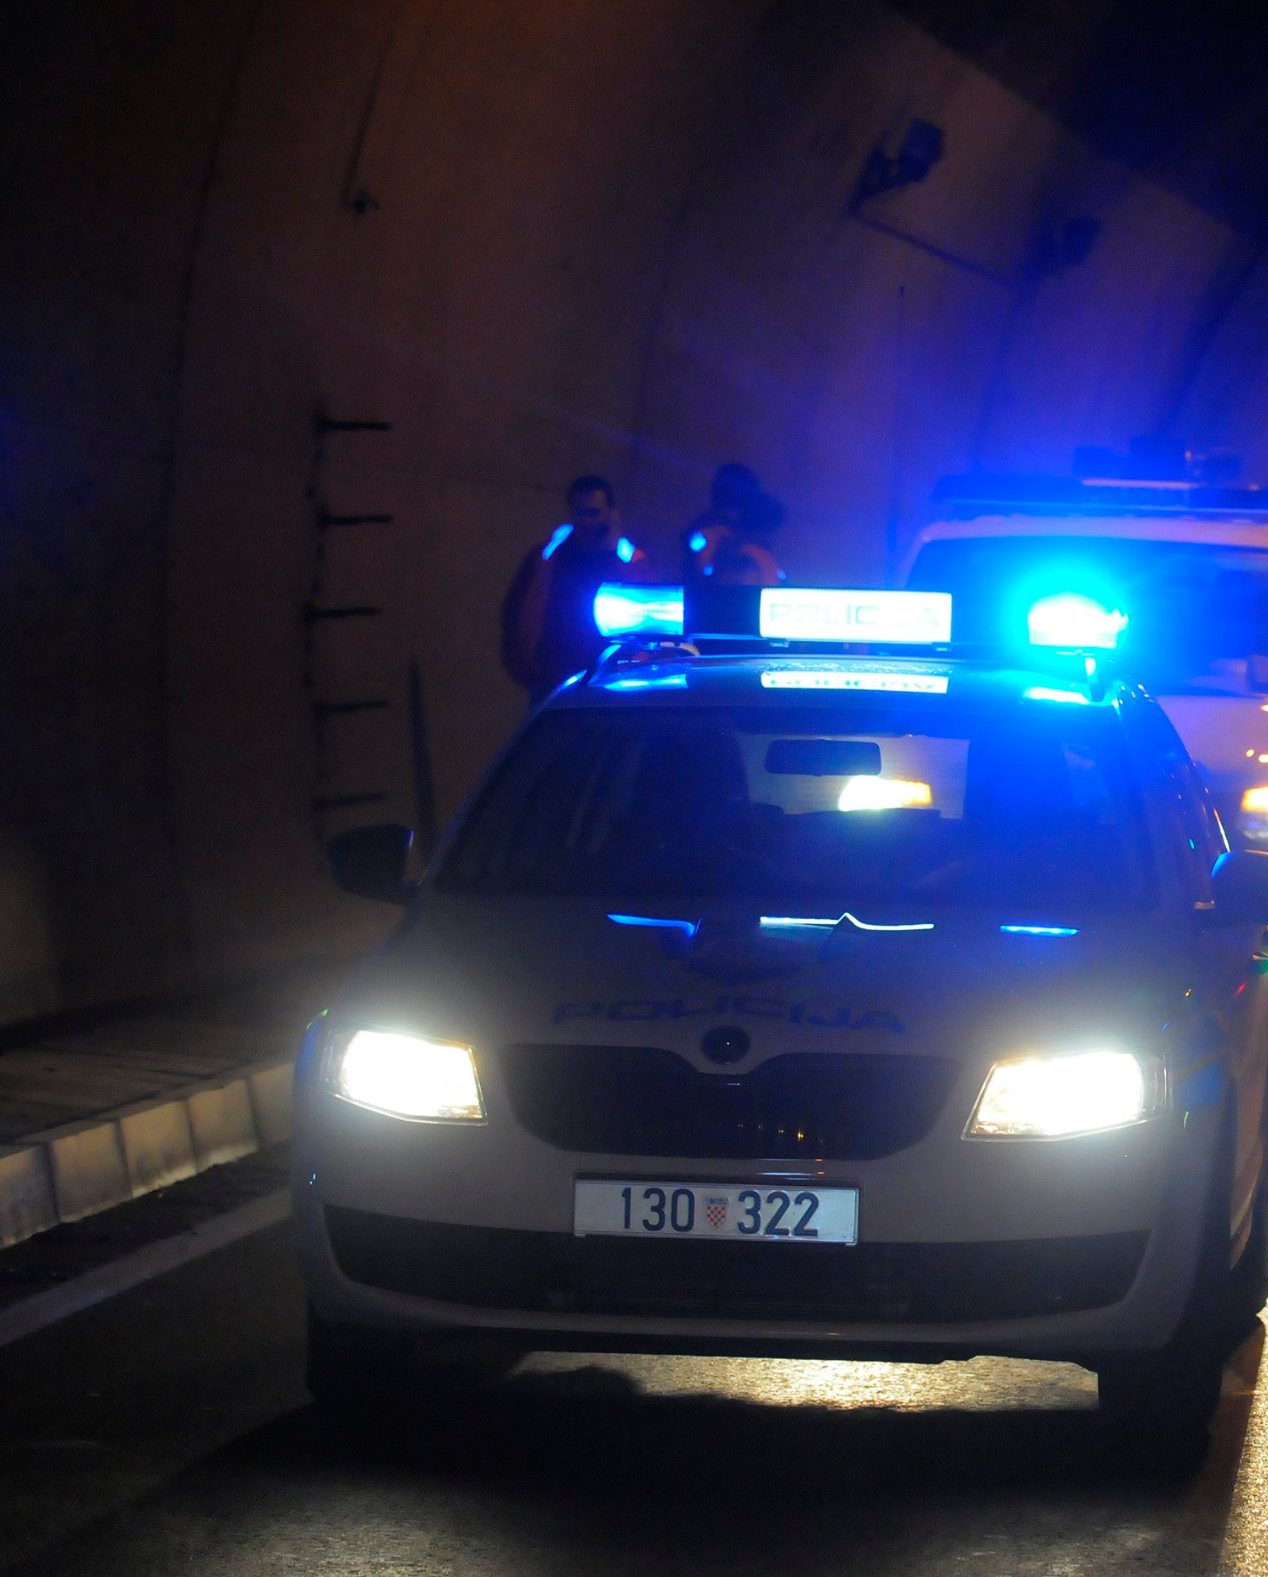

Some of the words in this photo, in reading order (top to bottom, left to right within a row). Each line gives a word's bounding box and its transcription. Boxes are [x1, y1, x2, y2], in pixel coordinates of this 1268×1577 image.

[553, 996, 905, 1034] POLICIJA
[621, 1187, 696, 1232] 130
[737, 1190, 819, 1237] 322
